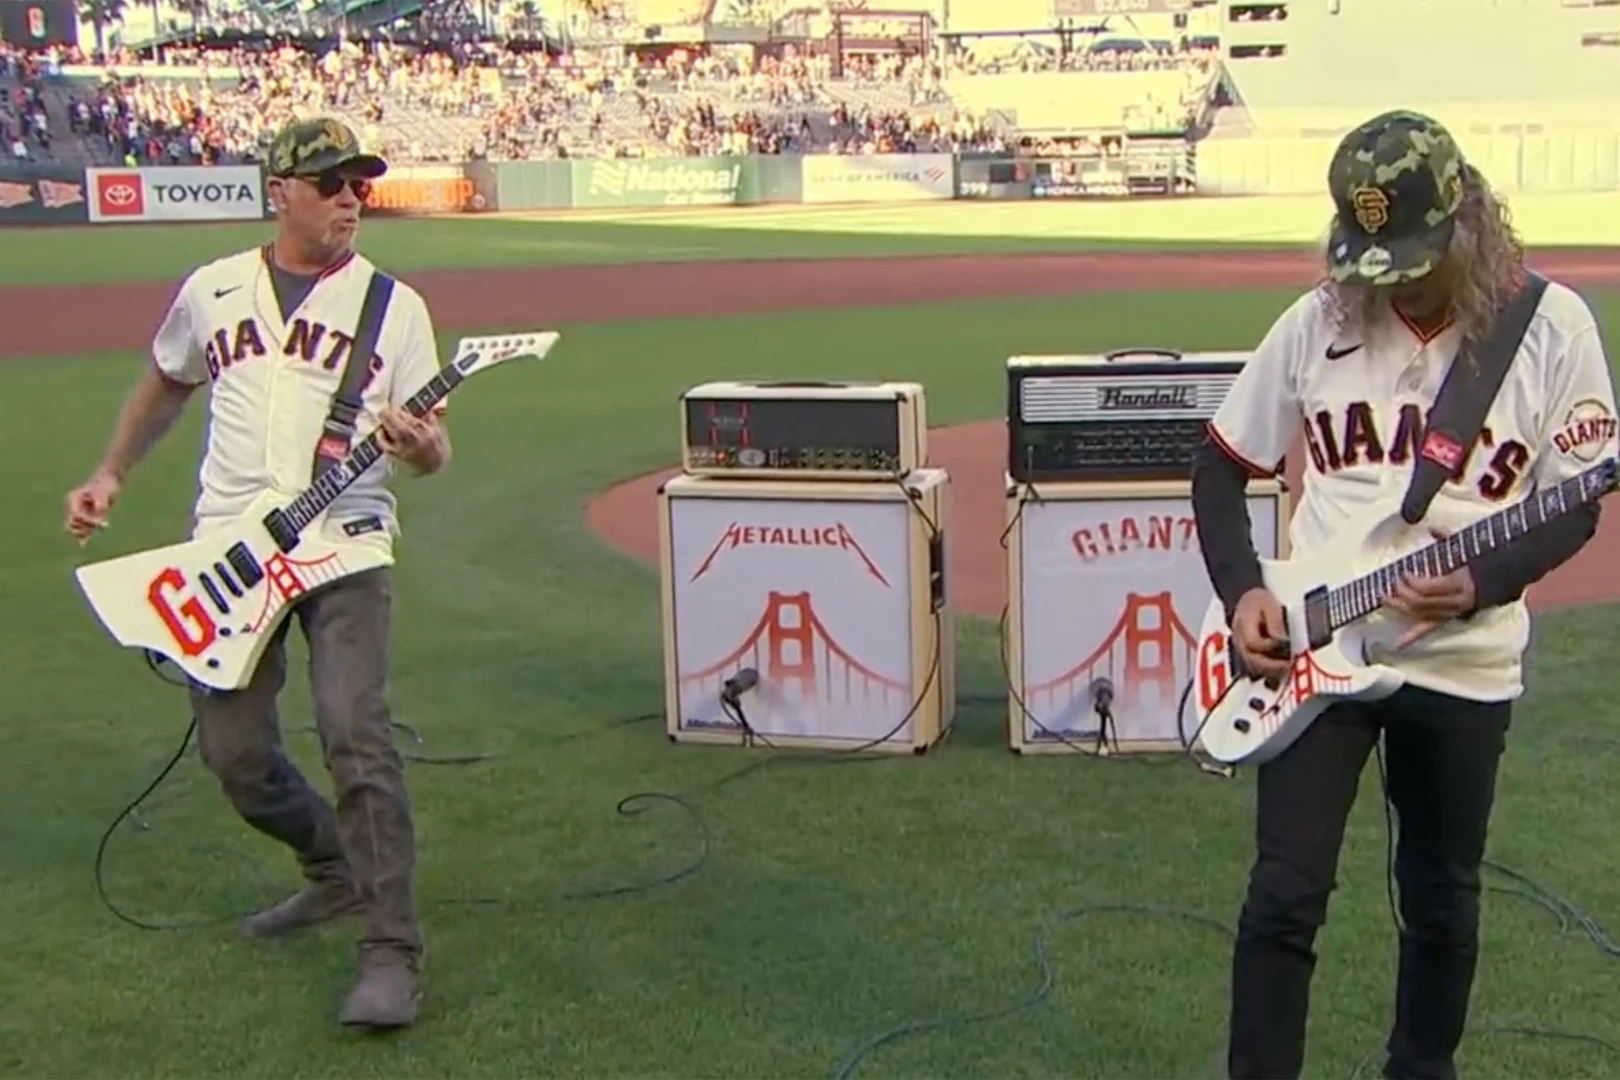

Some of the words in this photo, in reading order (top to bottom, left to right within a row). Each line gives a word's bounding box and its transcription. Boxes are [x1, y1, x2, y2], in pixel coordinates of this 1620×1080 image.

[626, 163, 740, 192] National
[866, 171, 920, 182] AMERICA
[153, 184, 254, 203] TOYOTA
[1103, 387, 1186, 406] Randall
[148, 567, 217, 657] G
[1200, 631, 1227, 711] G
